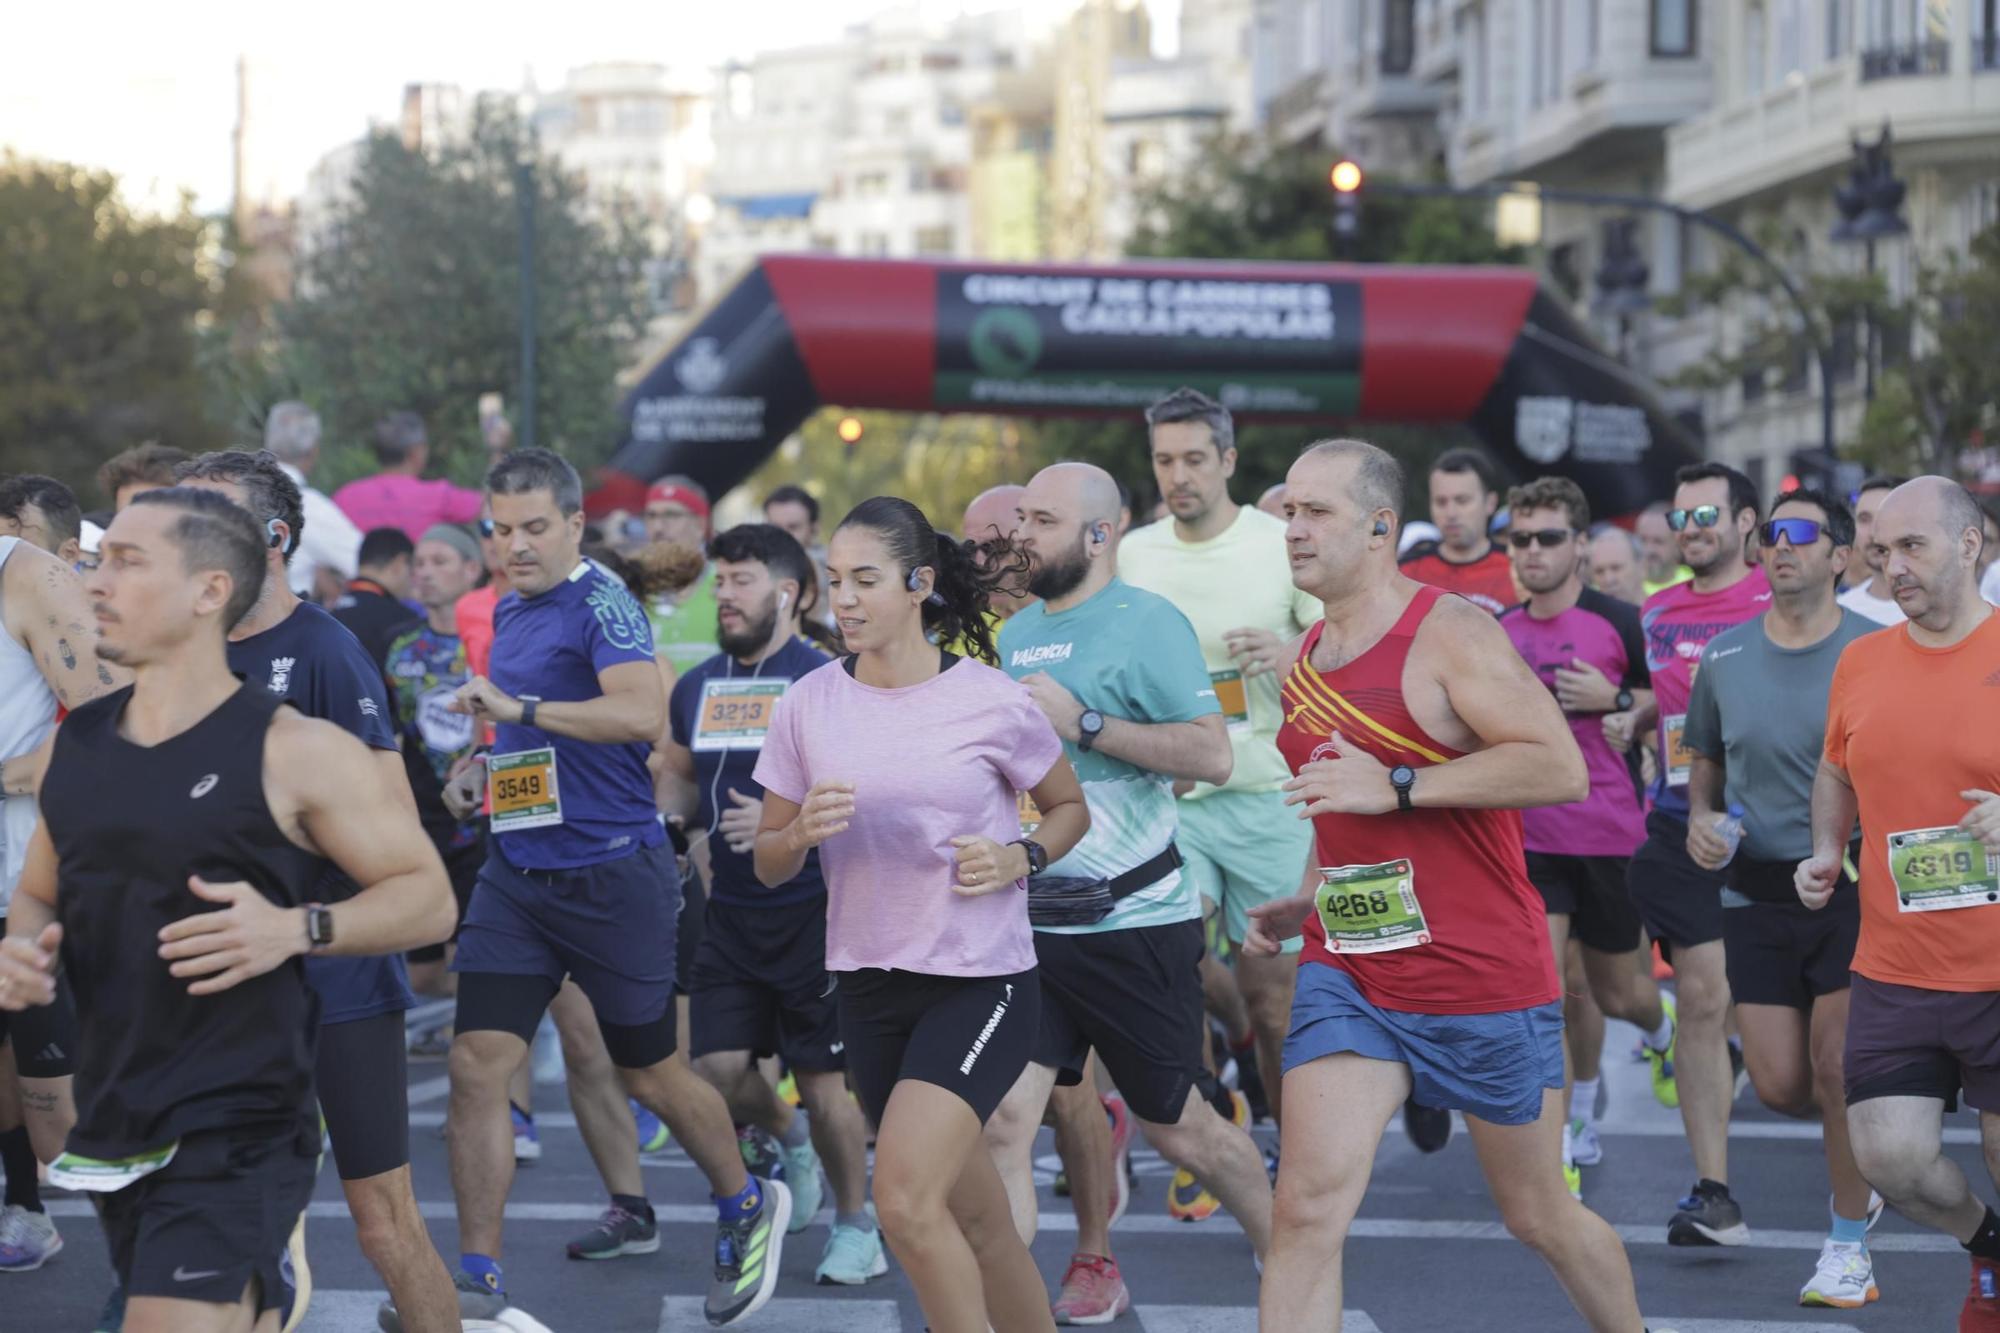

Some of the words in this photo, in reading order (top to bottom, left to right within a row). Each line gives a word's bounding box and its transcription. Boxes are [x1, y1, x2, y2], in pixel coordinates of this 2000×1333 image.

[963, 275, 1093, 305] CIRCUIT
[1098, 278, 1145, 306] DE
[1149, 280, 1332, 311] CARRERES
[1011, 642, 1073, 666] VALENCIA
[712, 703, 763, 721] 3213
[497, 775, 540, 799] 3549
[1326, 890, 1389, 918] 4268
[978, 1004, 1006, 1044] SWOOSH
[971, 1039, 985, 1055] BY
[959, 1050, 978, 1075] NIKE
